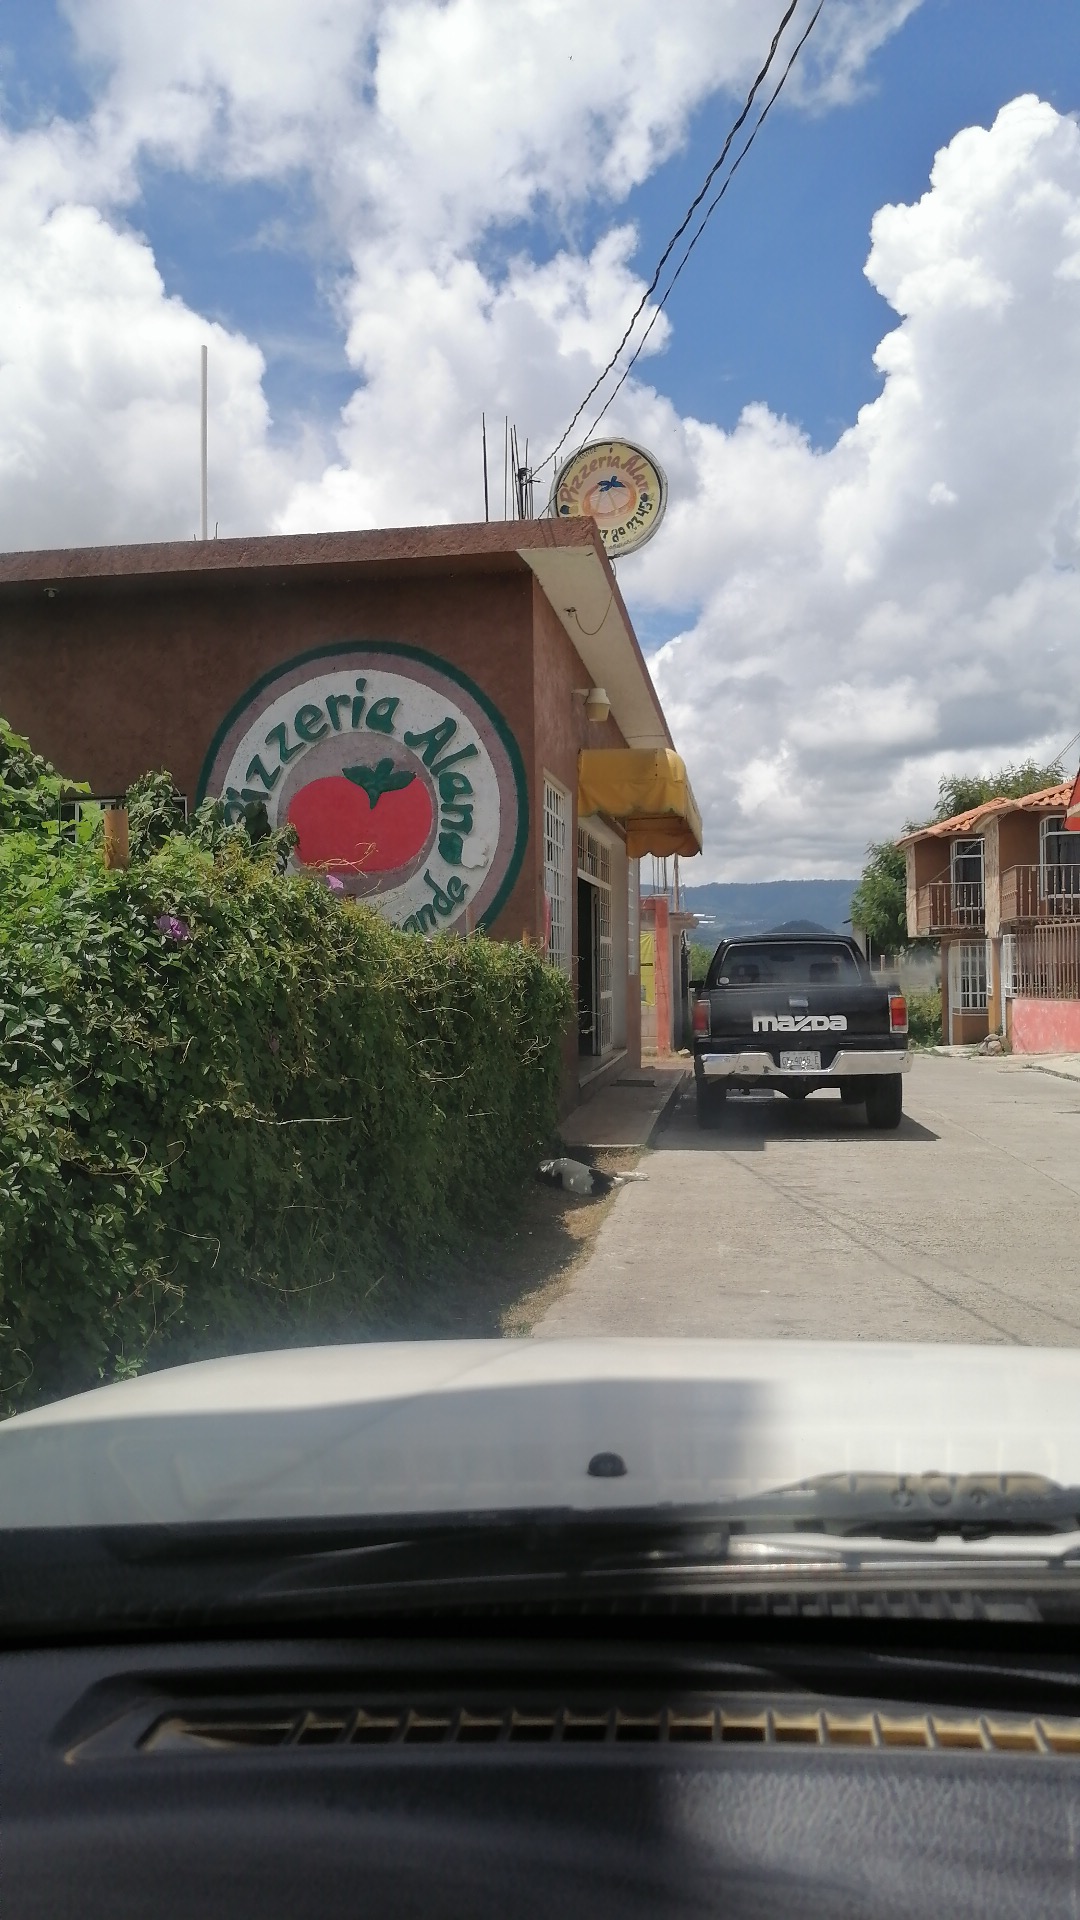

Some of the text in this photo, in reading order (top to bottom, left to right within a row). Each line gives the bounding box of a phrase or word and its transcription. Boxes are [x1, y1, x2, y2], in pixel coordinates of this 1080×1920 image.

[560, 447, 621, 503] Pizzeria
[404, 717, 478, 835] Alan
[396, 868, 469, 934] ande
